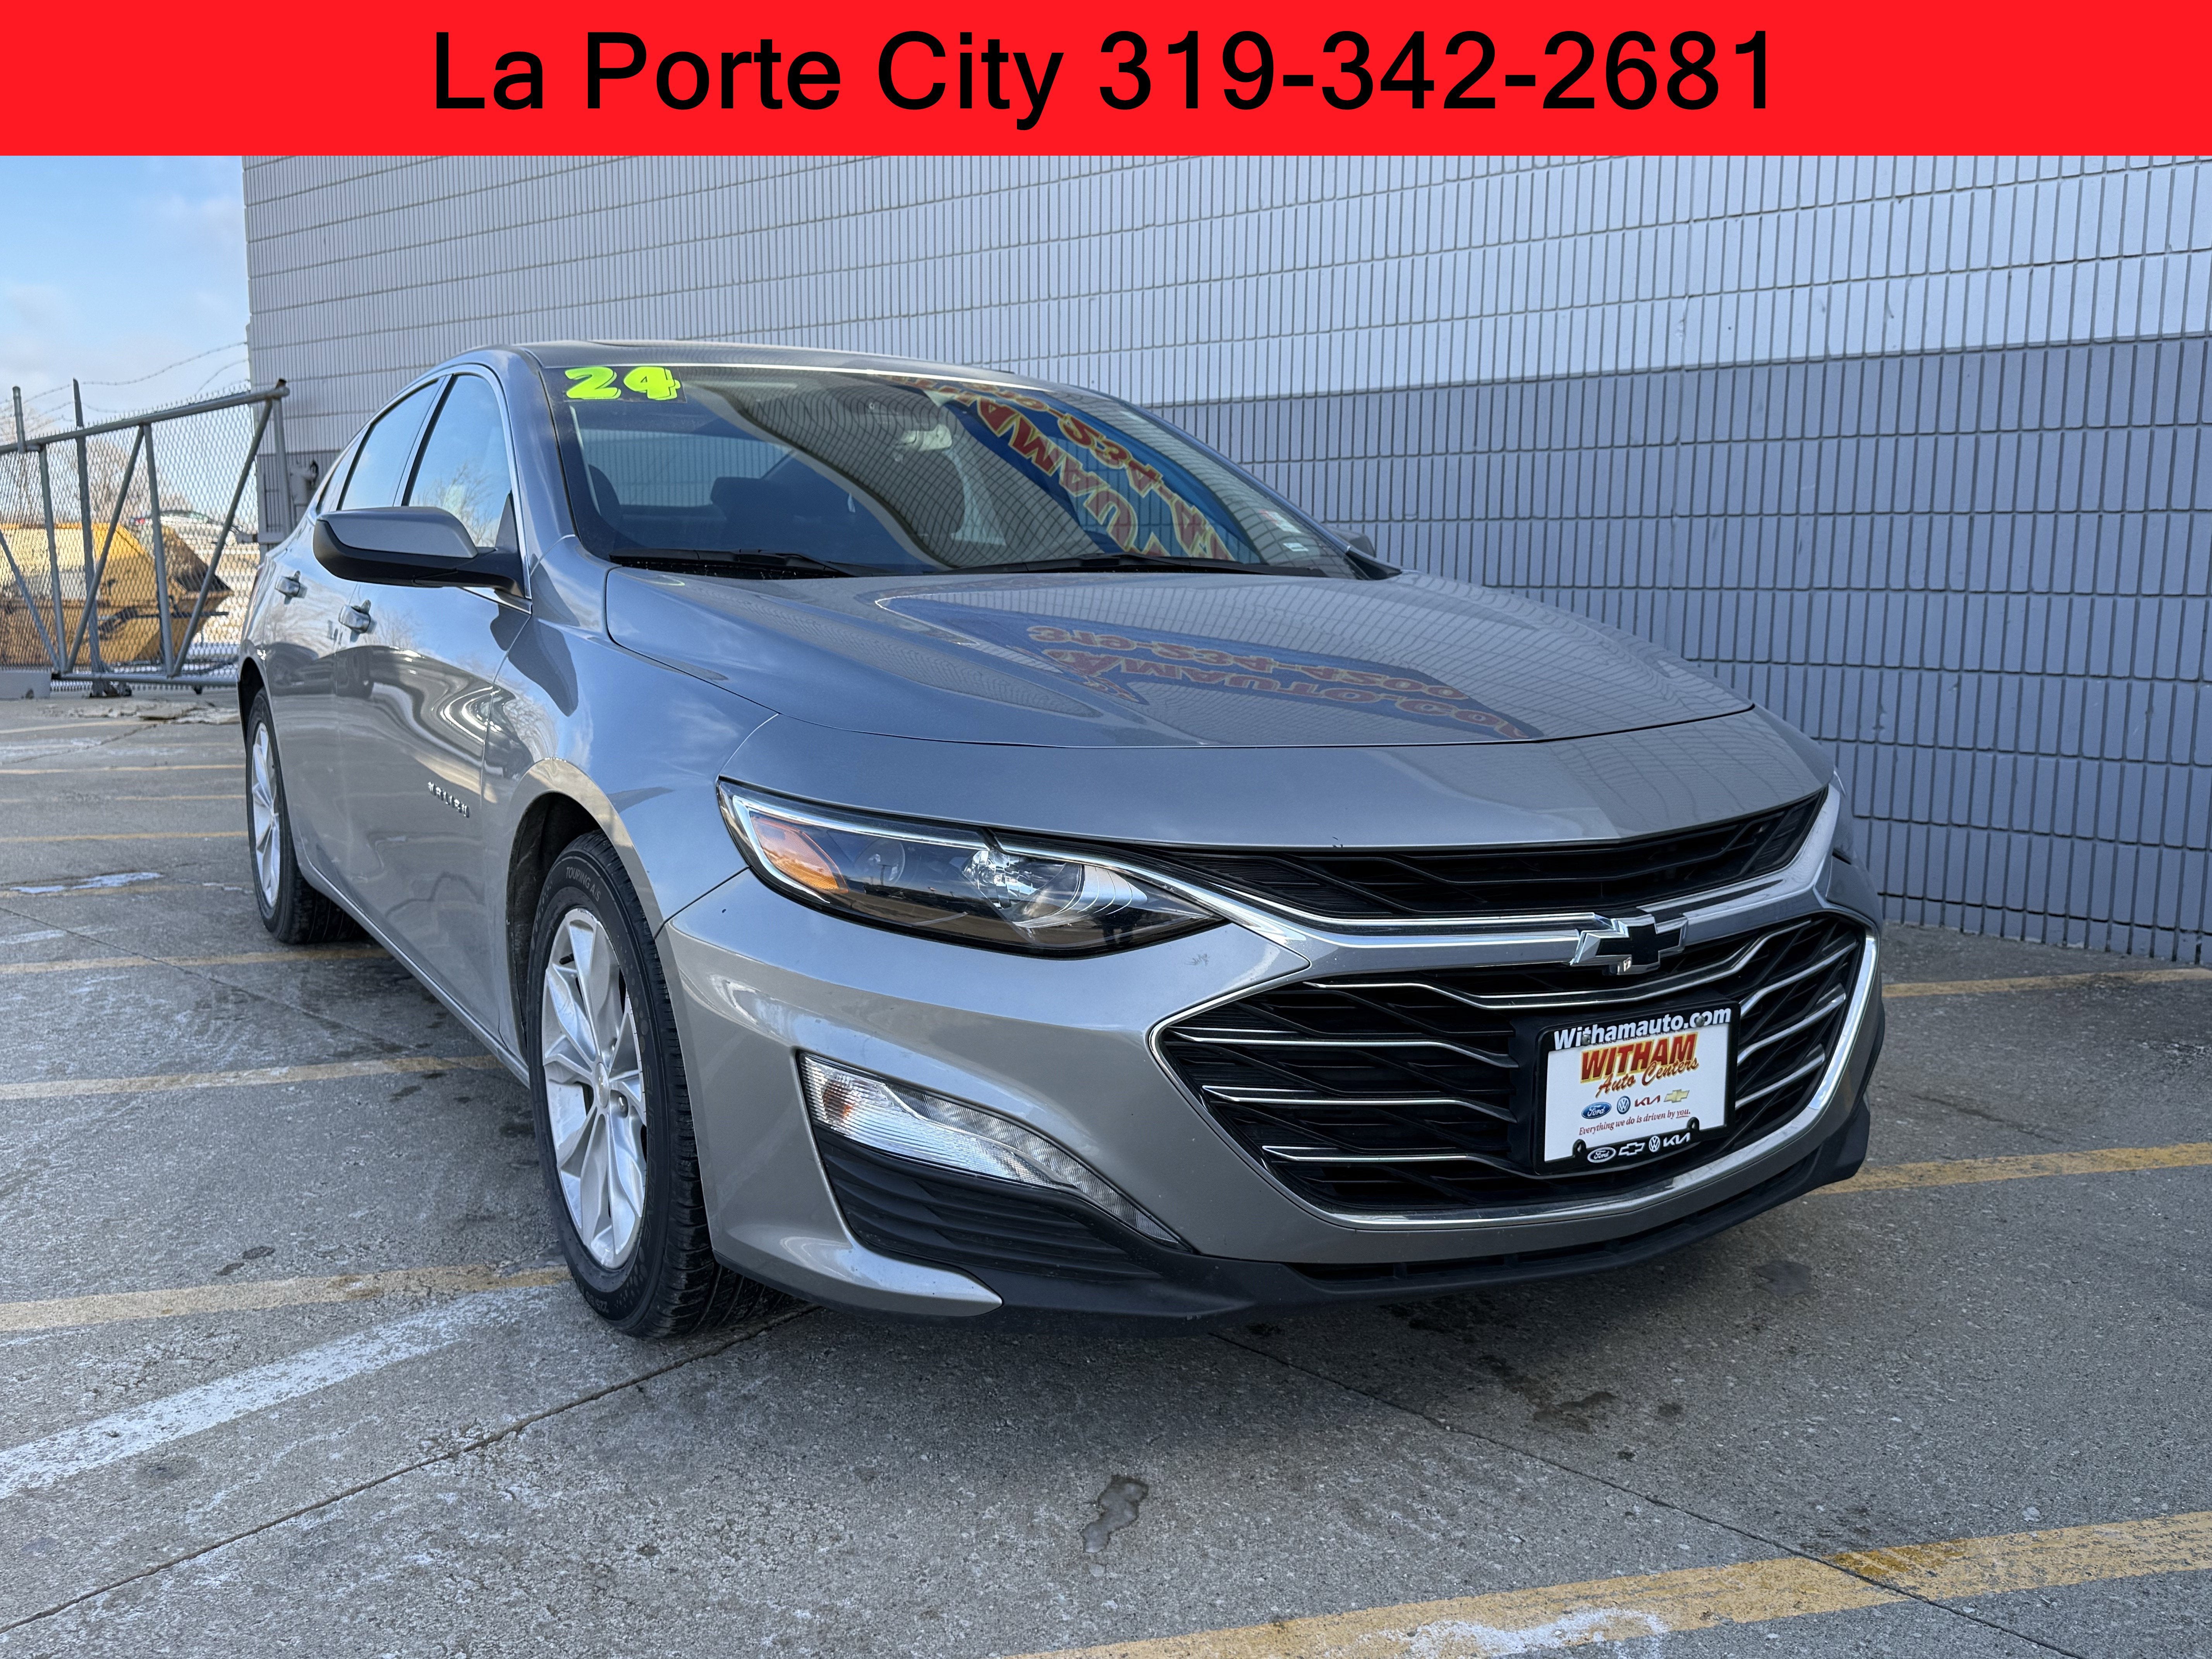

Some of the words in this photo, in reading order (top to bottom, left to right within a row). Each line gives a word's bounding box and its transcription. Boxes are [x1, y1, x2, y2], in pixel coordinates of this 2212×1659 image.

[565, 366, 680, 400] 24
[566, 867, 591, 889] TOURING
[1554, 1008, 1731, 1050] Withamauto.com
[1580, 1032, 1698, 1084] WITHAM
[1595, 1072, 1636, 1098] Auto
[1642, 1058, 1699, 1087] Centers
[1579, 1121, 1614, 1135] Everything
[1626, 1116, 1635, 1125] do
[1644, 1112, 1666, 1122] driven
[1667, 1110, 1675, 1119] by
[1676, 1109, 1691, 1118] you.
